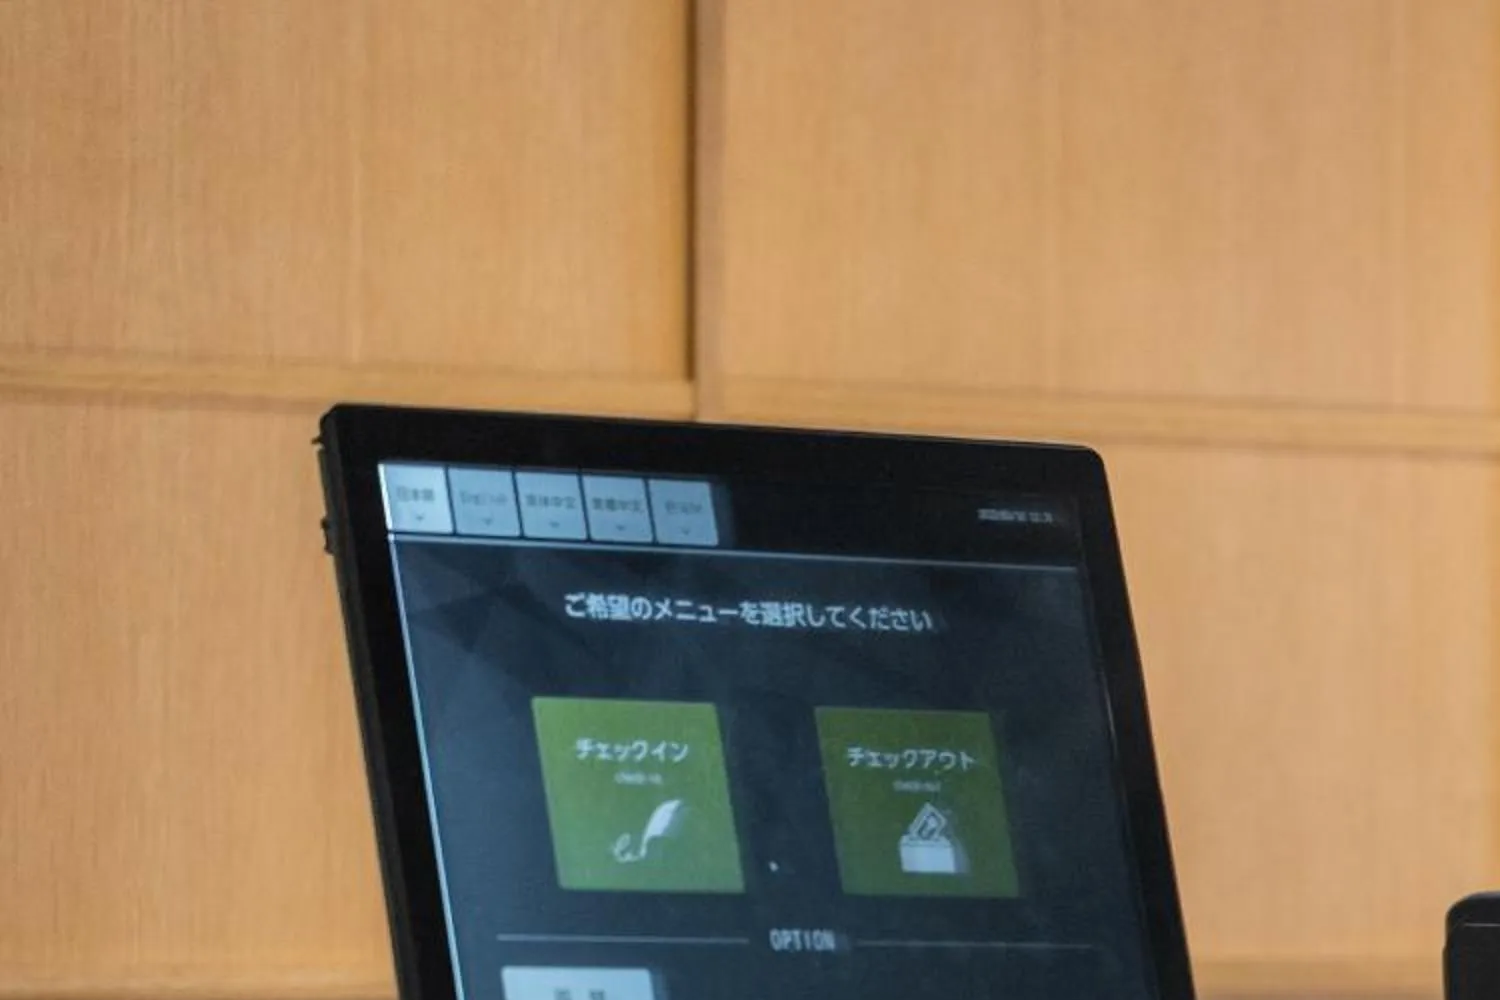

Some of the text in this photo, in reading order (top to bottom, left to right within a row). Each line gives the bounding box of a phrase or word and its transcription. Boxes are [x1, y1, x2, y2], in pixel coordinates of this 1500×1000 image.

[564, 593, 933, 631] ご希望のメニューを選択してください
[576, 737, 689, 762] チェックイン
[847, 747, 976, 771] チェックアウト
[768, 928, 836, 951] OPTION
